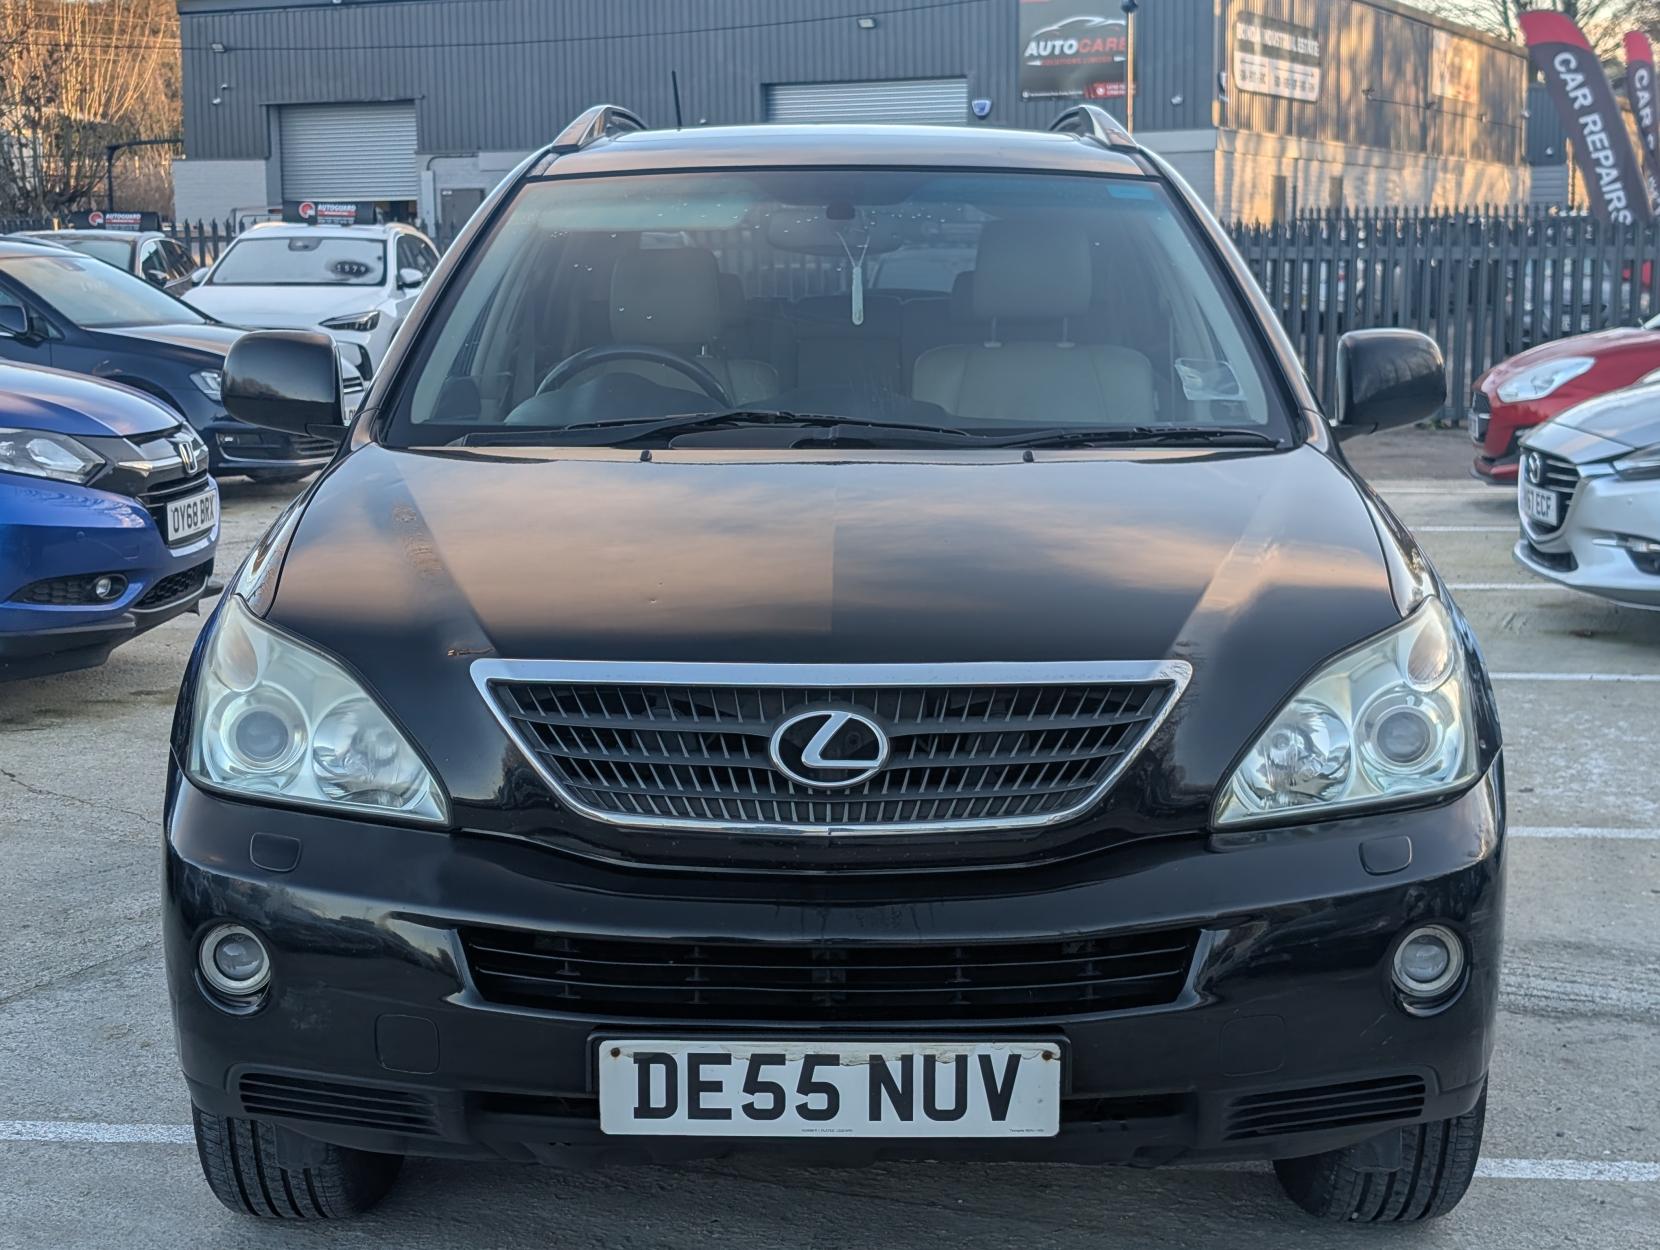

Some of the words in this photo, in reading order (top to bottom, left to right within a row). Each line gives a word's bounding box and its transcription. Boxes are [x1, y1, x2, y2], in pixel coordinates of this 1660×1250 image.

[1634, 68, 1652, 127] CAR
[1553, 52, 1594, 110] CAR
[1578, 112, 1633, 226] REPAIRS
[172, 501, 199, 533] OY68
[200, 494, 215, 525] BRX
[632, 1051, 841, 1122] DE55
[868, 1053, 1022, 1122] NUV
